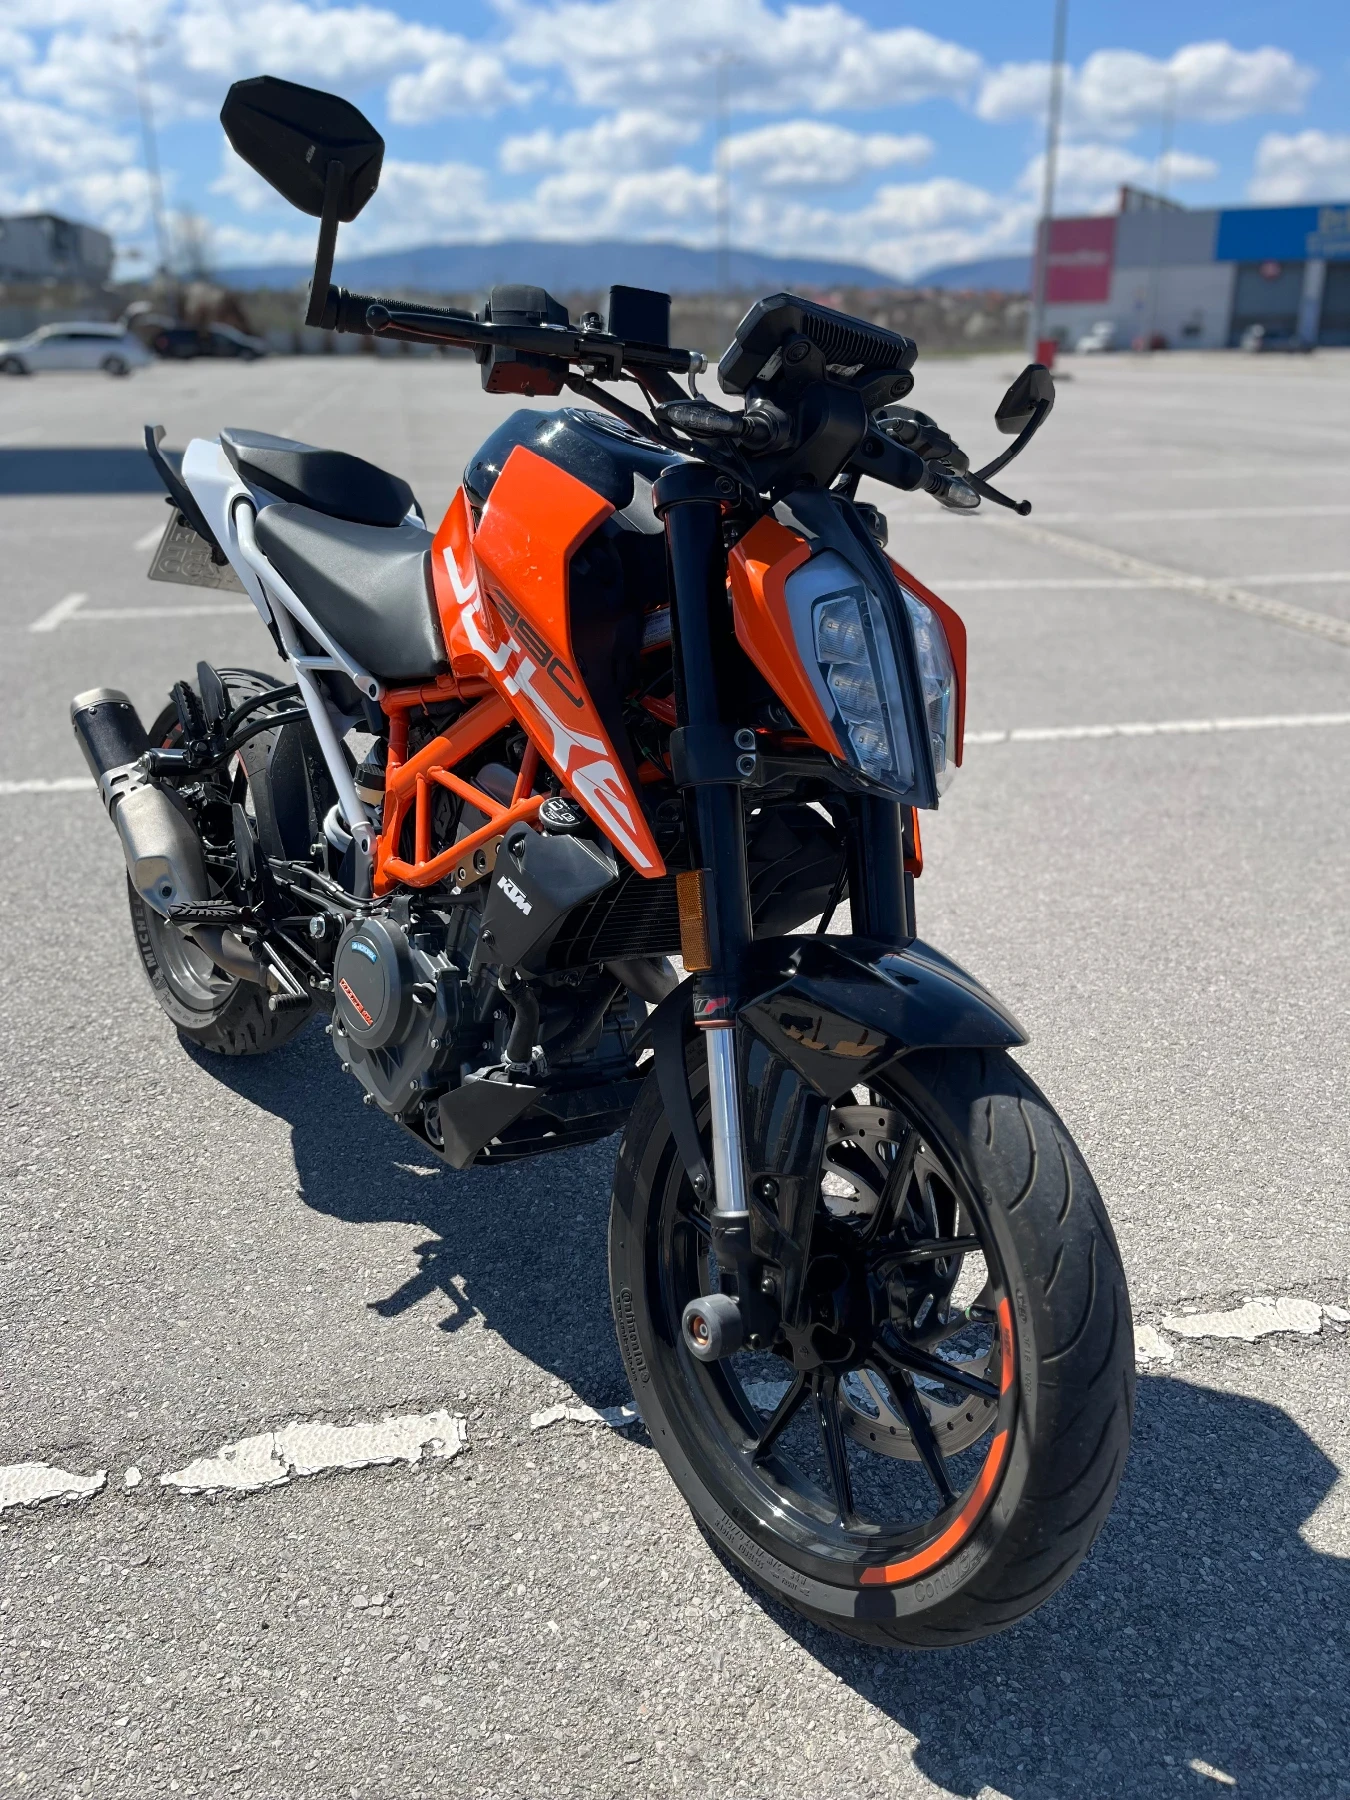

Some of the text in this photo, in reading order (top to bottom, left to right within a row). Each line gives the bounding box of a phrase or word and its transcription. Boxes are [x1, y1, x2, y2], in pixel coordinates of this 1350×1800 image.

[497, 875, 533, 916] KTM
[133, 896, 157, 968] MICHEL
[620, 1288, 648, 1372] Continental
